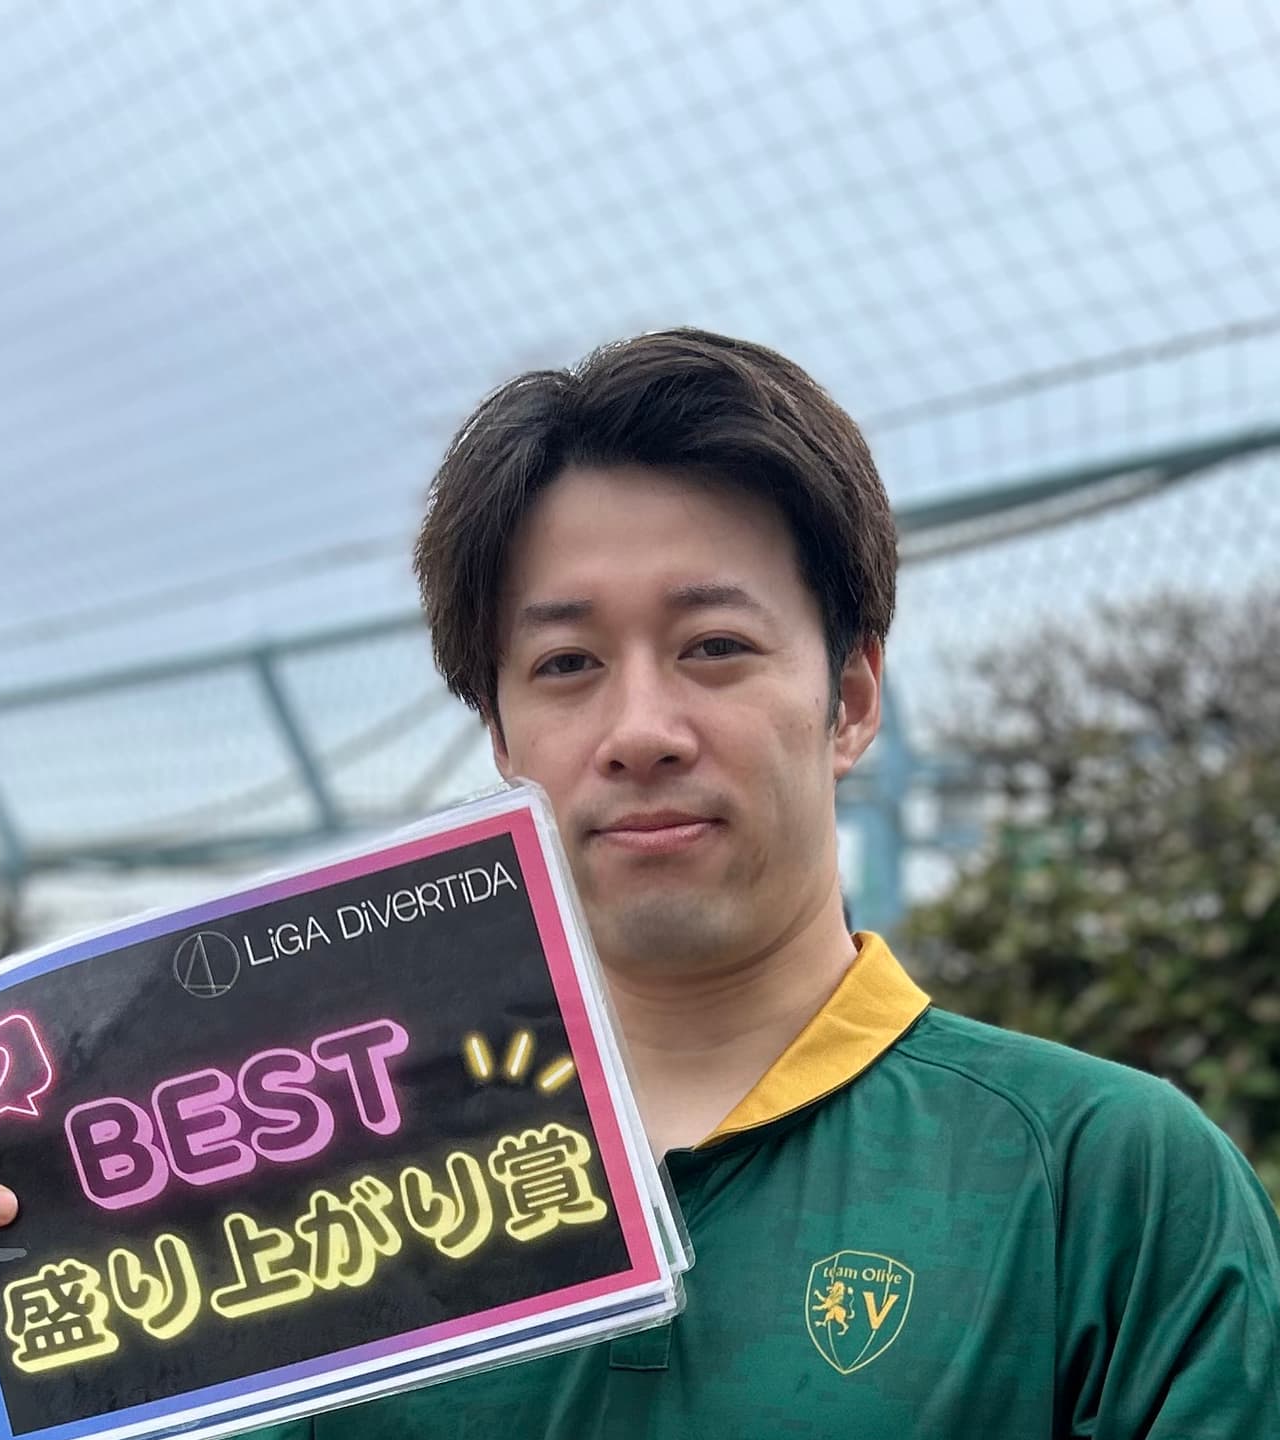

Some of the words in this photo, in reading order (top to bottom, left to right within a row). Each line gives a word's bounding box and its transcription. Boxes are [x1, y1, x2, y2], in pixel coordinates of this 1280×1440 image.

[64, 1019, 409, 1211] BEST
[2, 1123, 608, 1375] 盛り上がり賞
[823, 1266, 857, 1281] team
[861, 1267, 902, 1285] Olive
[862, 1291, 900, 1330] V
